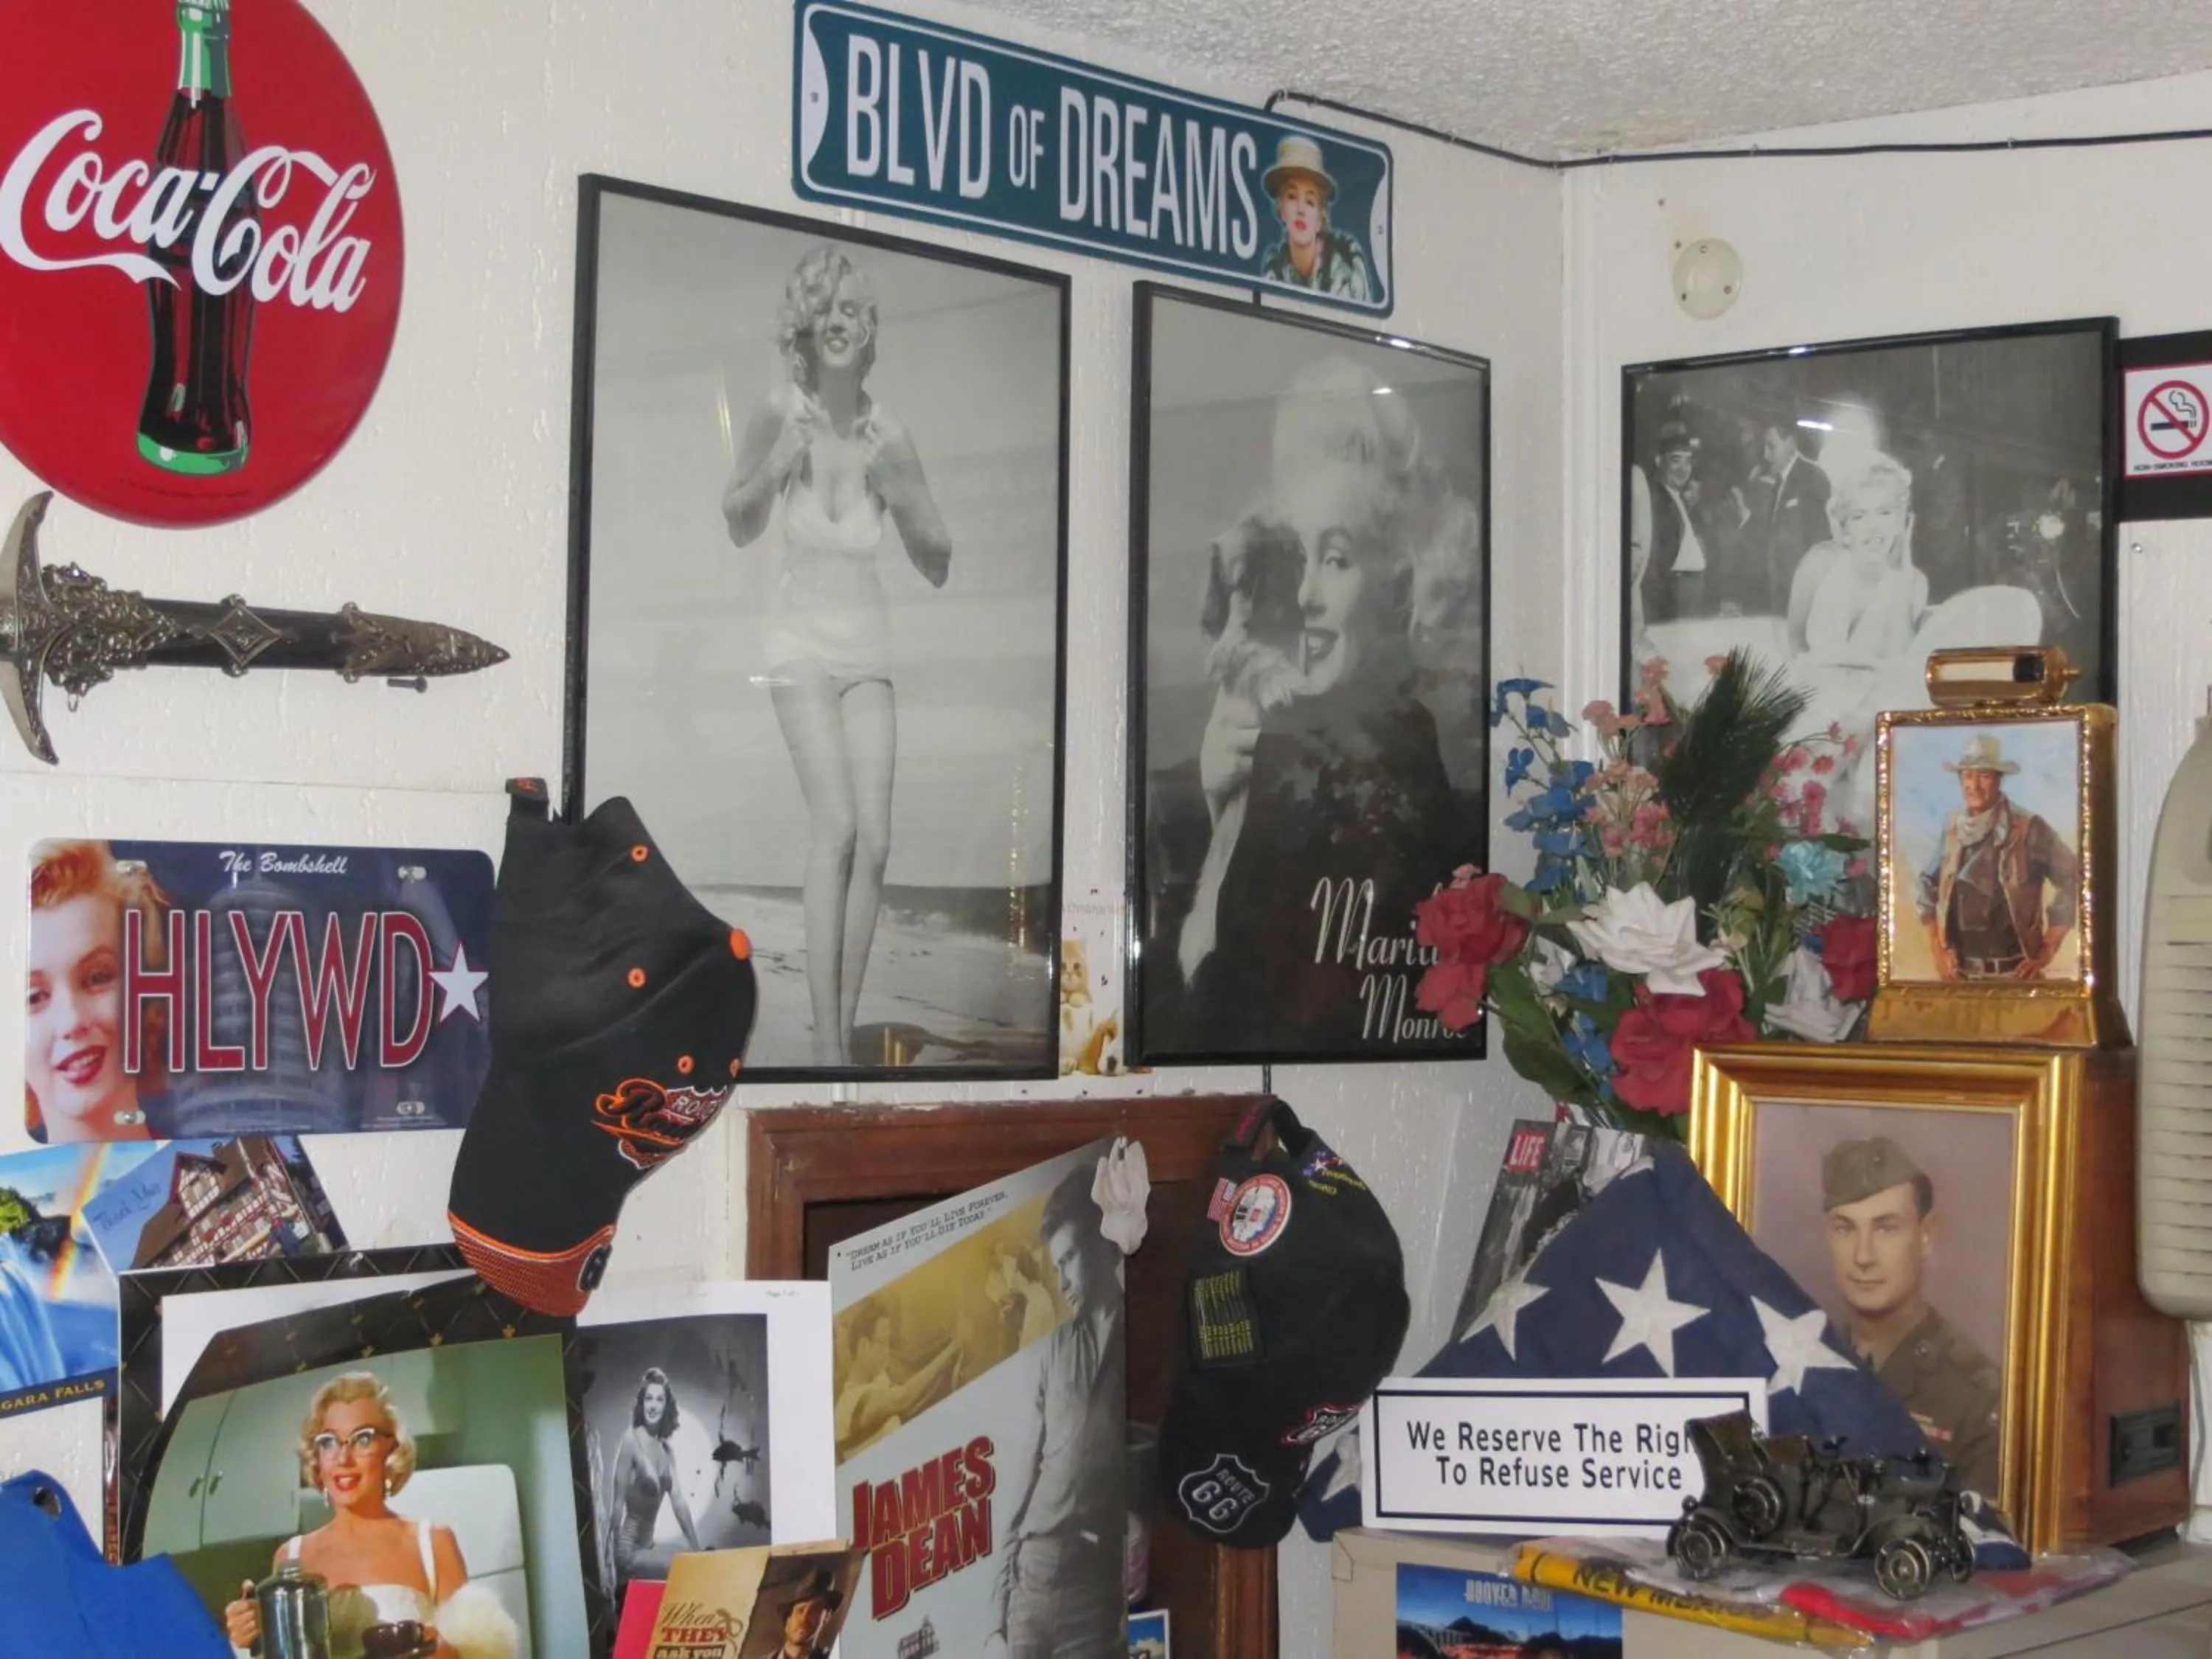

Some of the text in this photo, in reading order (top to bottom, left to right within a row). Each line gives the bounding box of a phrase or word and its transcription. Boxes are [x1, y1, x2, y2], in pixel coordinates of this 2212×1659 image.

[846, 34, 1257, 260] BLVD OF DREAMS
[0, 108, 377, 314] Coca-Cola
[219, 851, 348, 874] The Bombshell
[124, 909, 434, 1072] HLYWD
[1509, 1135, 1545, 1167] LIFE
[945, 1206, 966, 1222] LIVE
[851, 1256, 874, 1271] LIVE
[54, 1379, 105, 1399] FALLS
[1407, 1420, 1446, 1450] We
[1458, 1421, 1562, 1453] Reserve
[1573, 1422, 1623, 1454] The
[1216, 1468, 1255, 1504] ROUTE
[1436, 1455, 1682, 1491] To Refuse Service
[852, 1435, 996, 1550] JAMES
[1191, 1480, 1239, 1520] 66
[871, 1498, 993, 1622] DEAN
[661, 1627, 727, 1643] THEY
